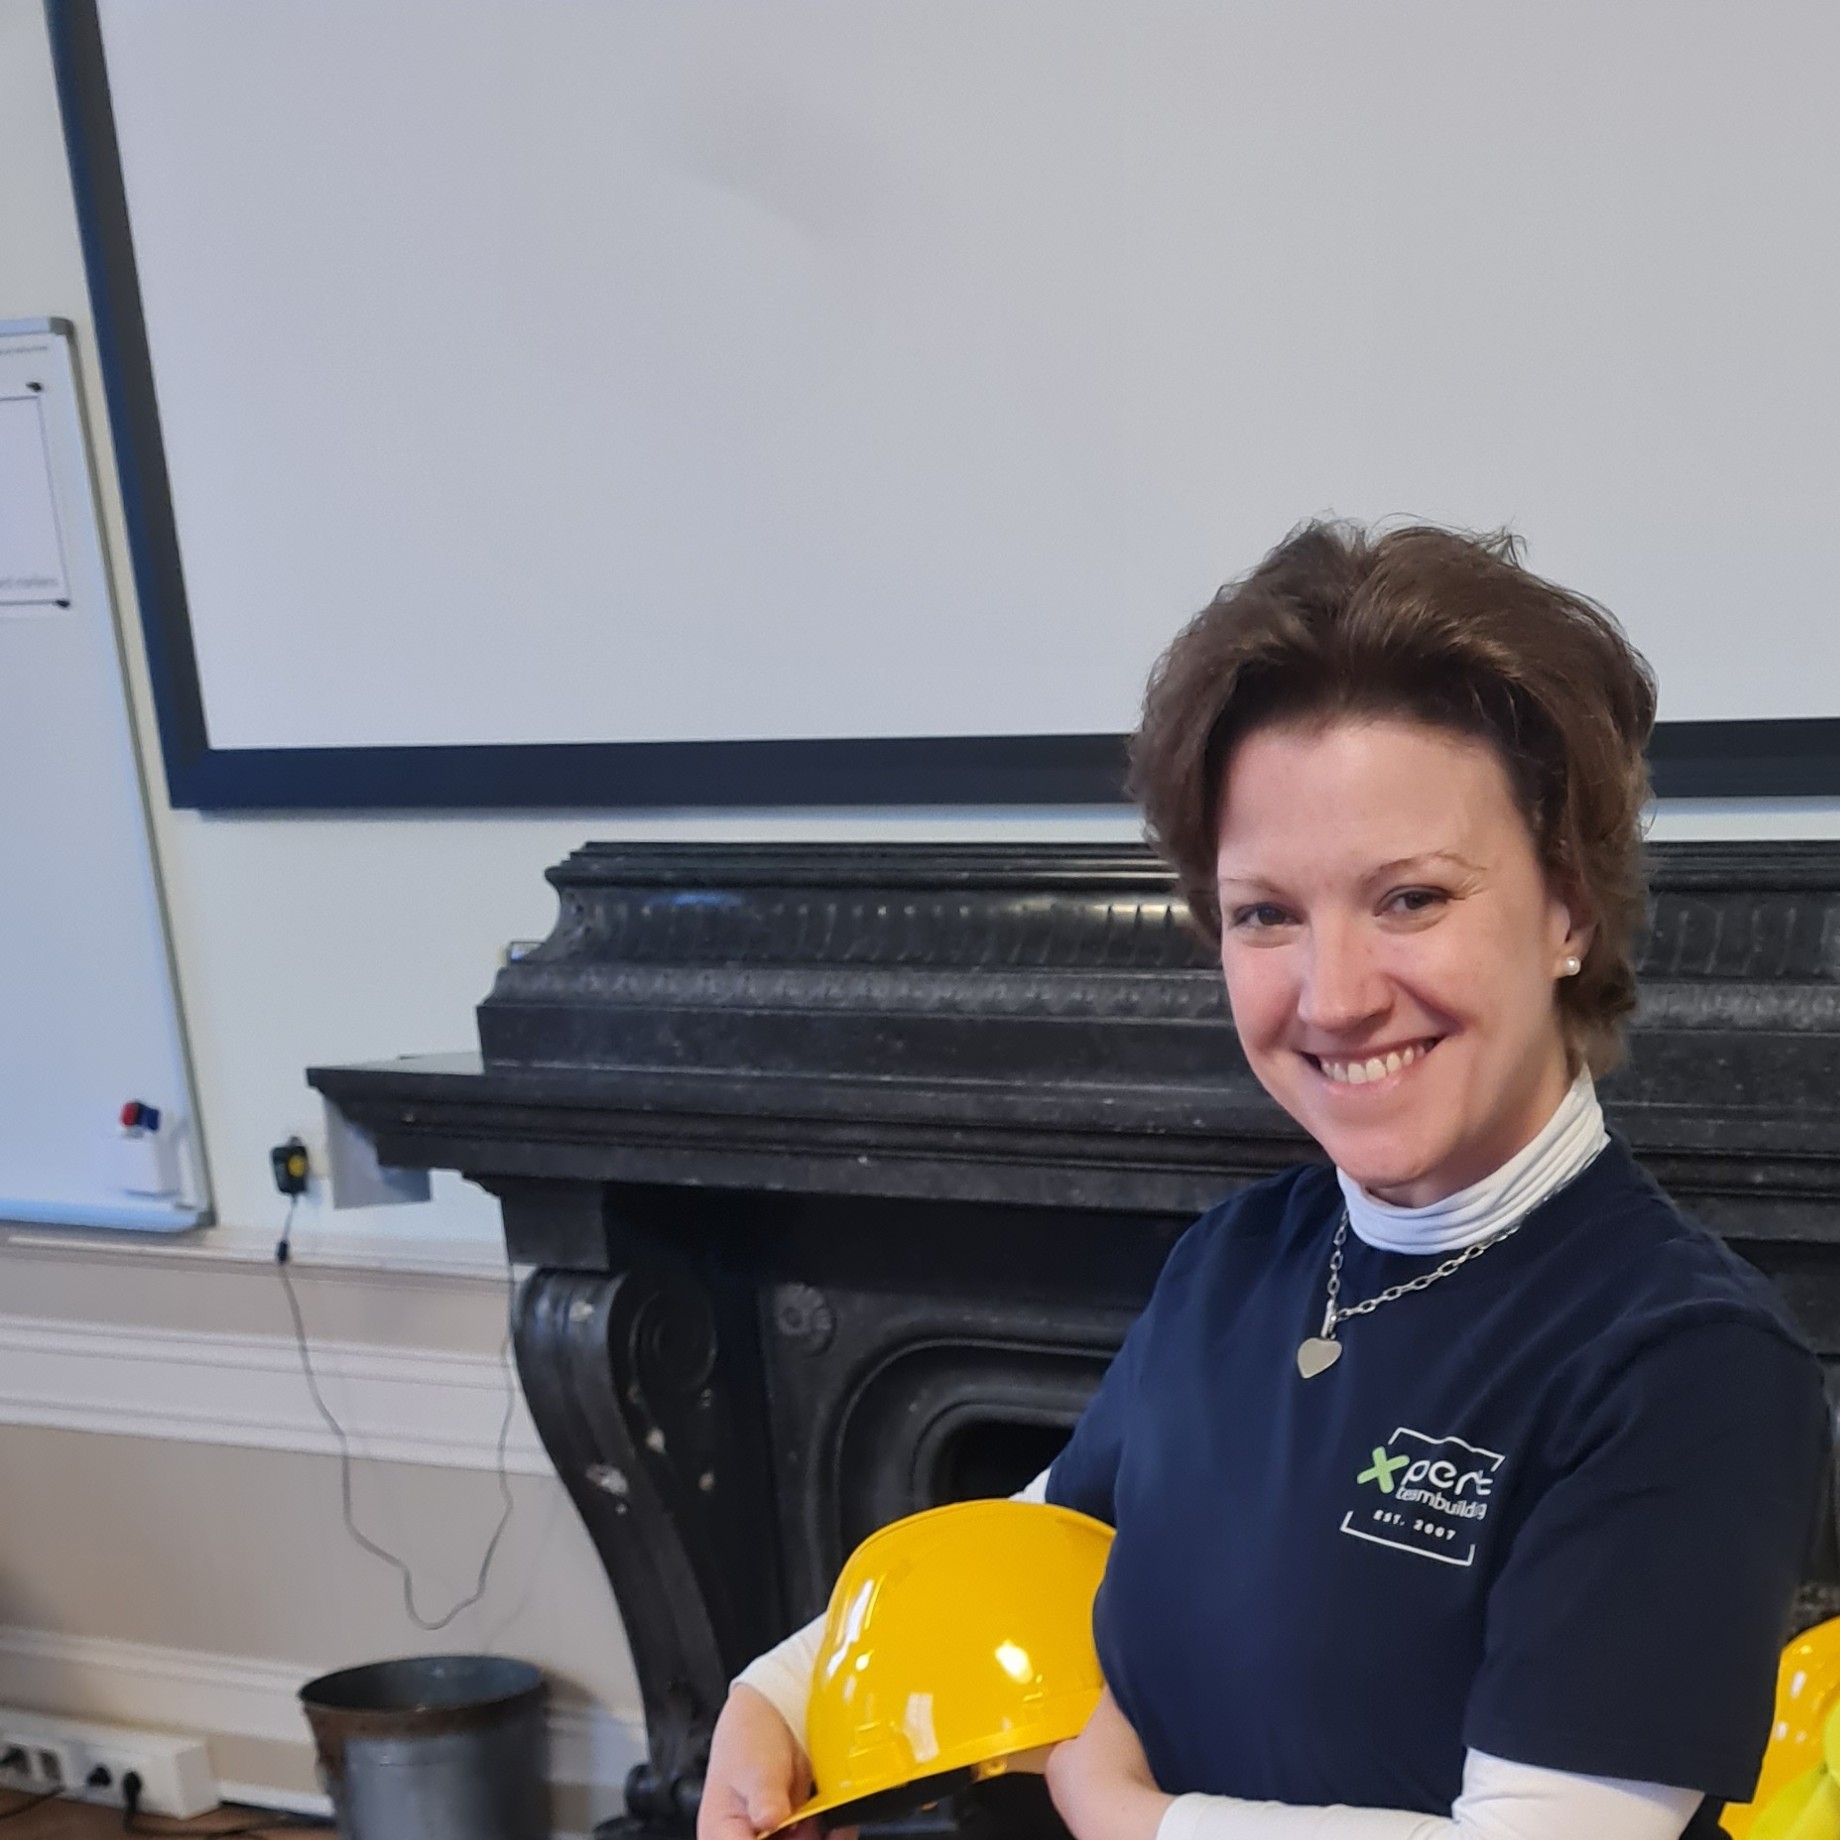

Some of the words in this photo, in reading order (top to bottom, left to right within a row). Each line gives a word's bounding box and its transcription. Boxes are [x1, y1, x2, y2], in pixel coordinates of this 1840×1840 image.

[1395, 1486, 1488, 1520] teambuildg
[1373, 1509, 1405, 1526] EST.
[1413, 1518, 1456, 1540] 2007
